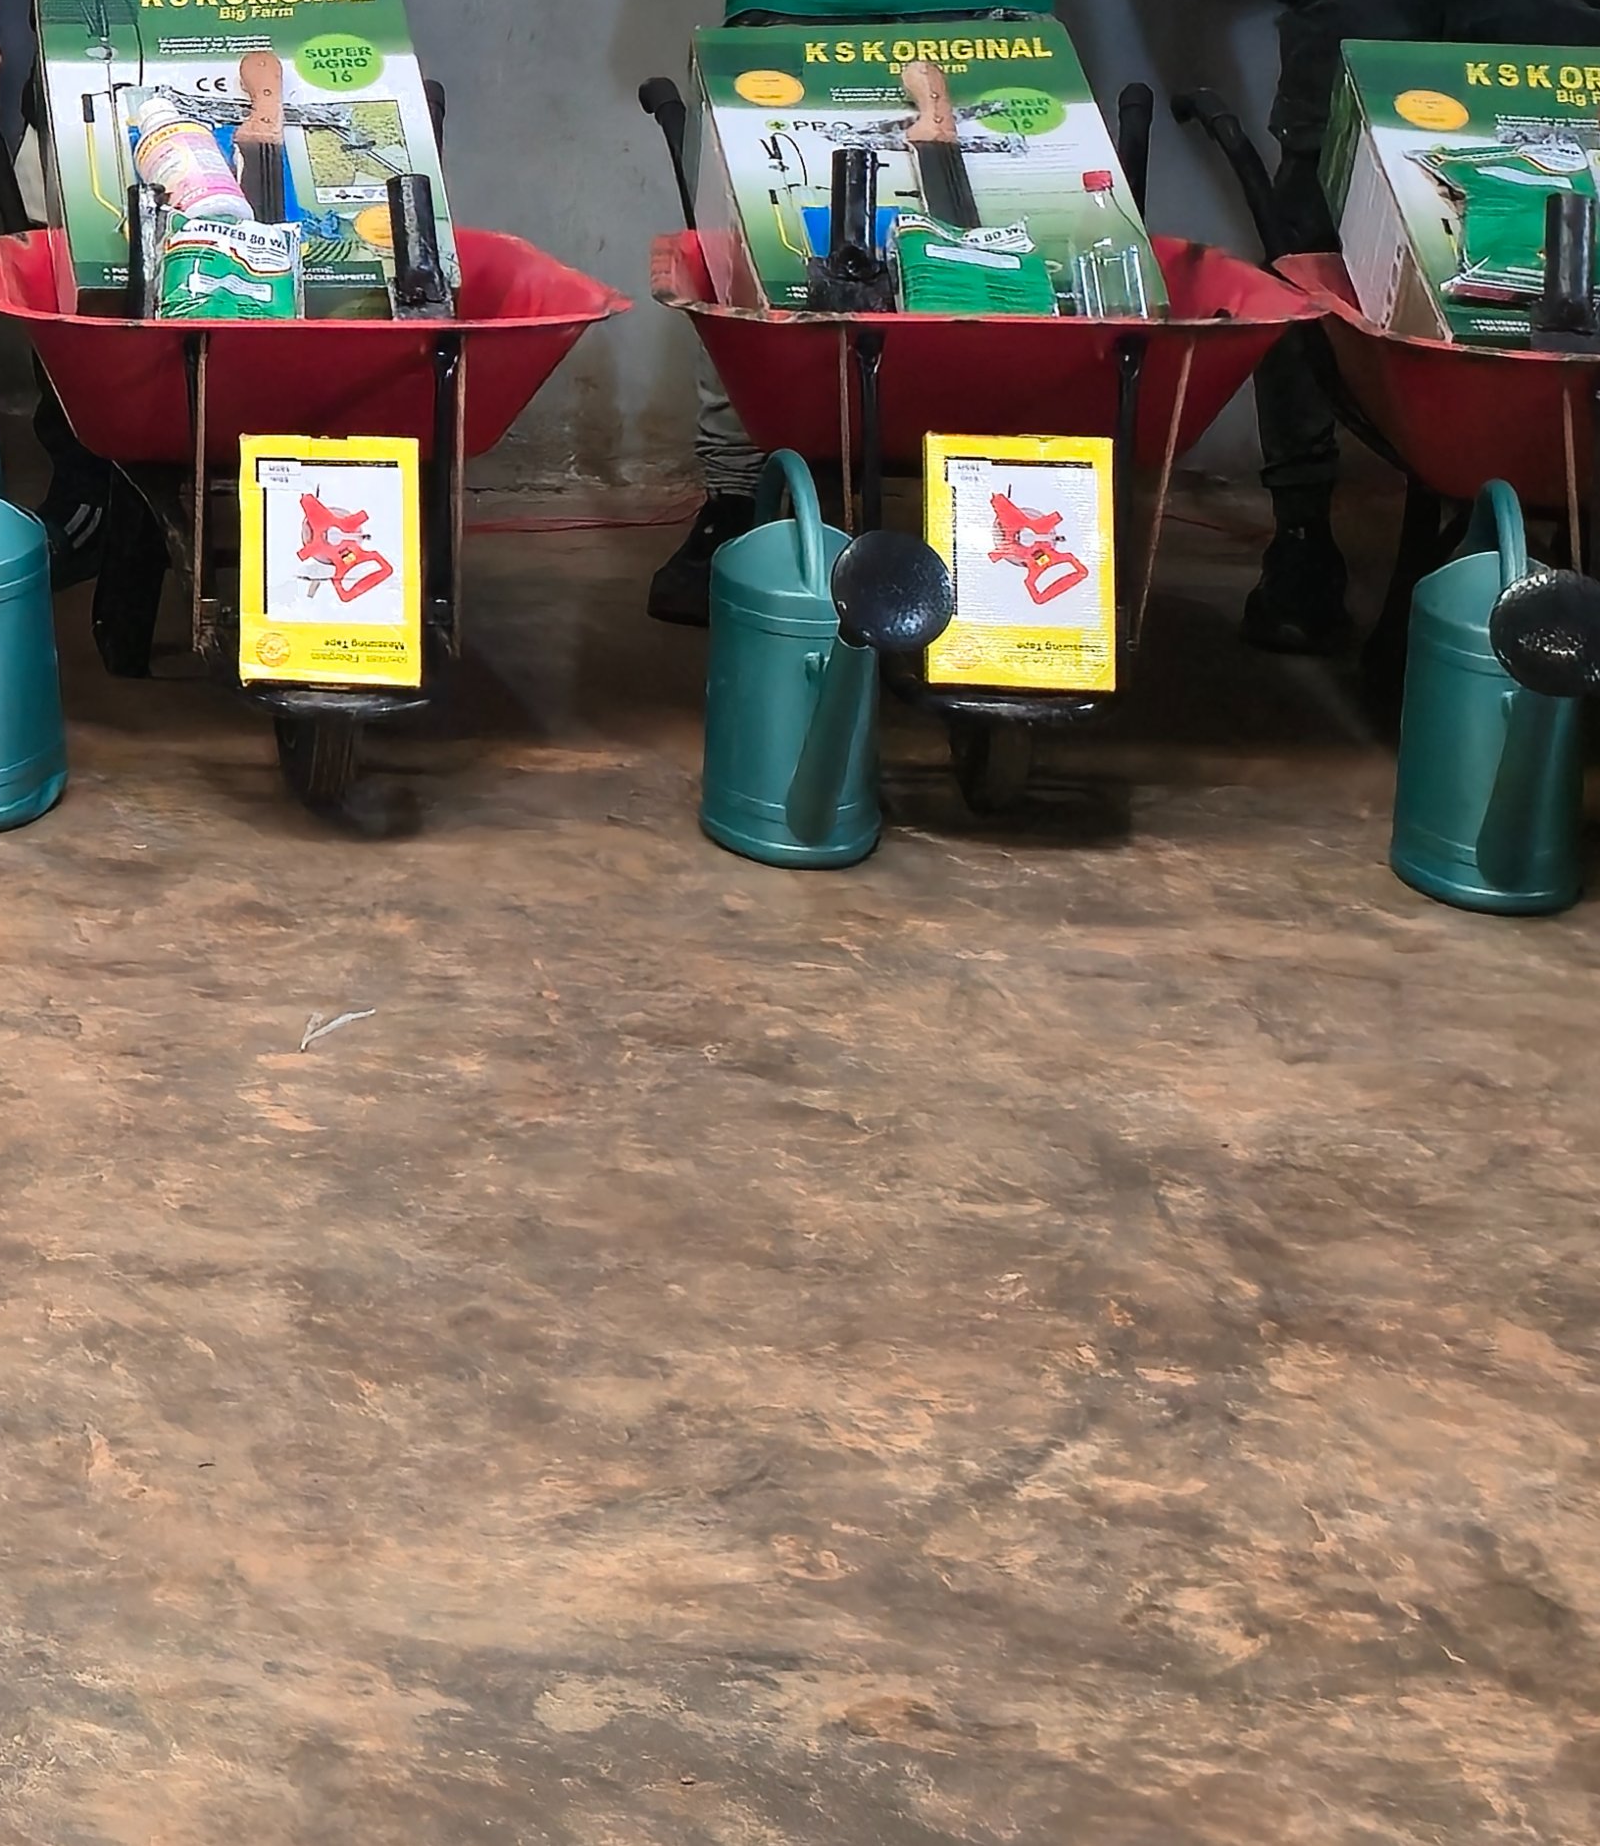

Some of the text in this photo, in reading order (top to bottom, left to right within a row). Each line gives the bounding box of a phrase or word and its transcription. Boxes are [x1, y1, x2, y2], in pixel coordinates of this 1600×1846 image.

[219, 5, 295, 22] Big Farm
[305, 47, 372, 59] SUPER
[804, 37, 1052, 63] K S K ORIGINAL
[312, 57, 368, 70] AGRO
[330, 70, 353, 83] 16
[1465, 62, 1492, 86] K
[1497, 64, 1521, 88] S
[1526, 64, 1552, 88] K
[196, 77, 228, 92] CE
[1009, 97, 1050, 106] PER
[1556, 89, 1587, 106] Big
[250, 233, 267, 246] 80
